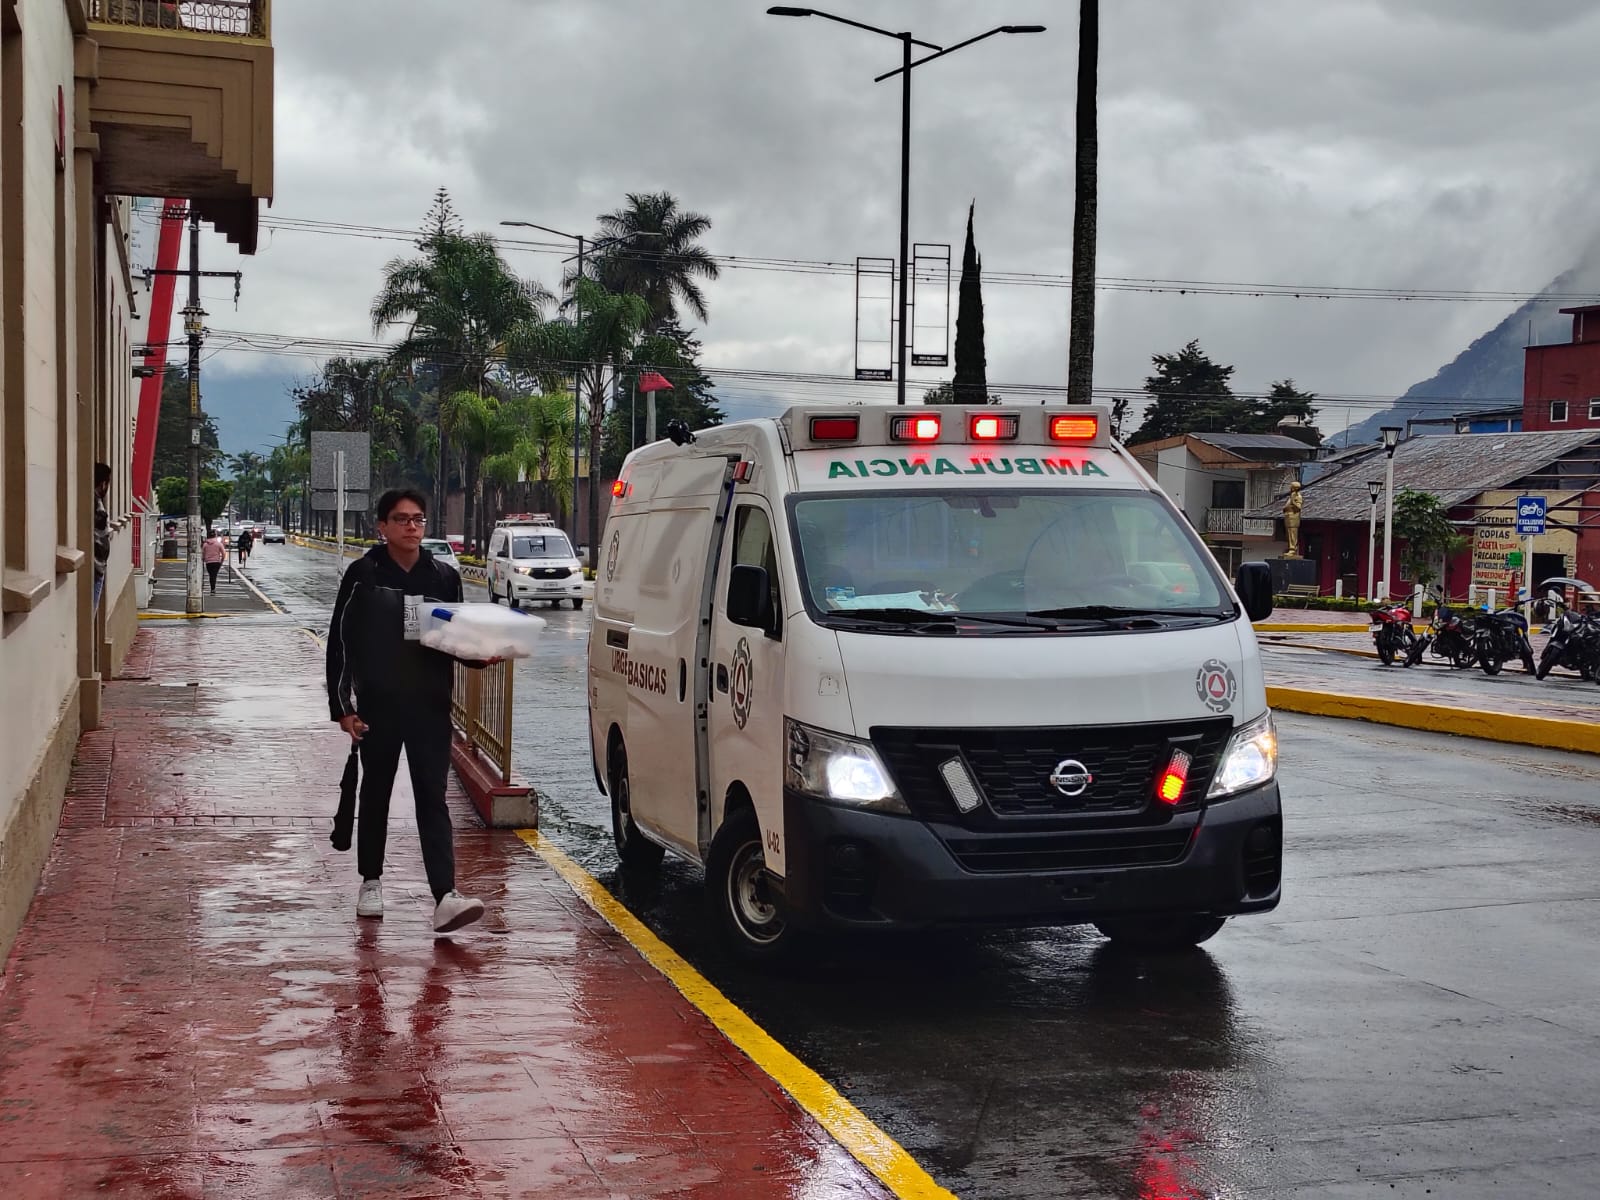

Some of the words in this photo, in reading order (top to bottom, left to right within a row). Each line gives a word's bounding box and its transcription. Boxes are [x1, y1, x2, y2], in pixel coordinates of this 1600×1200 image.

[1480, 530, 1510, 539] COPIAS
[1478, 541, 1498, 550] CASETA
[628, 660, 667, 695] BASICAS
